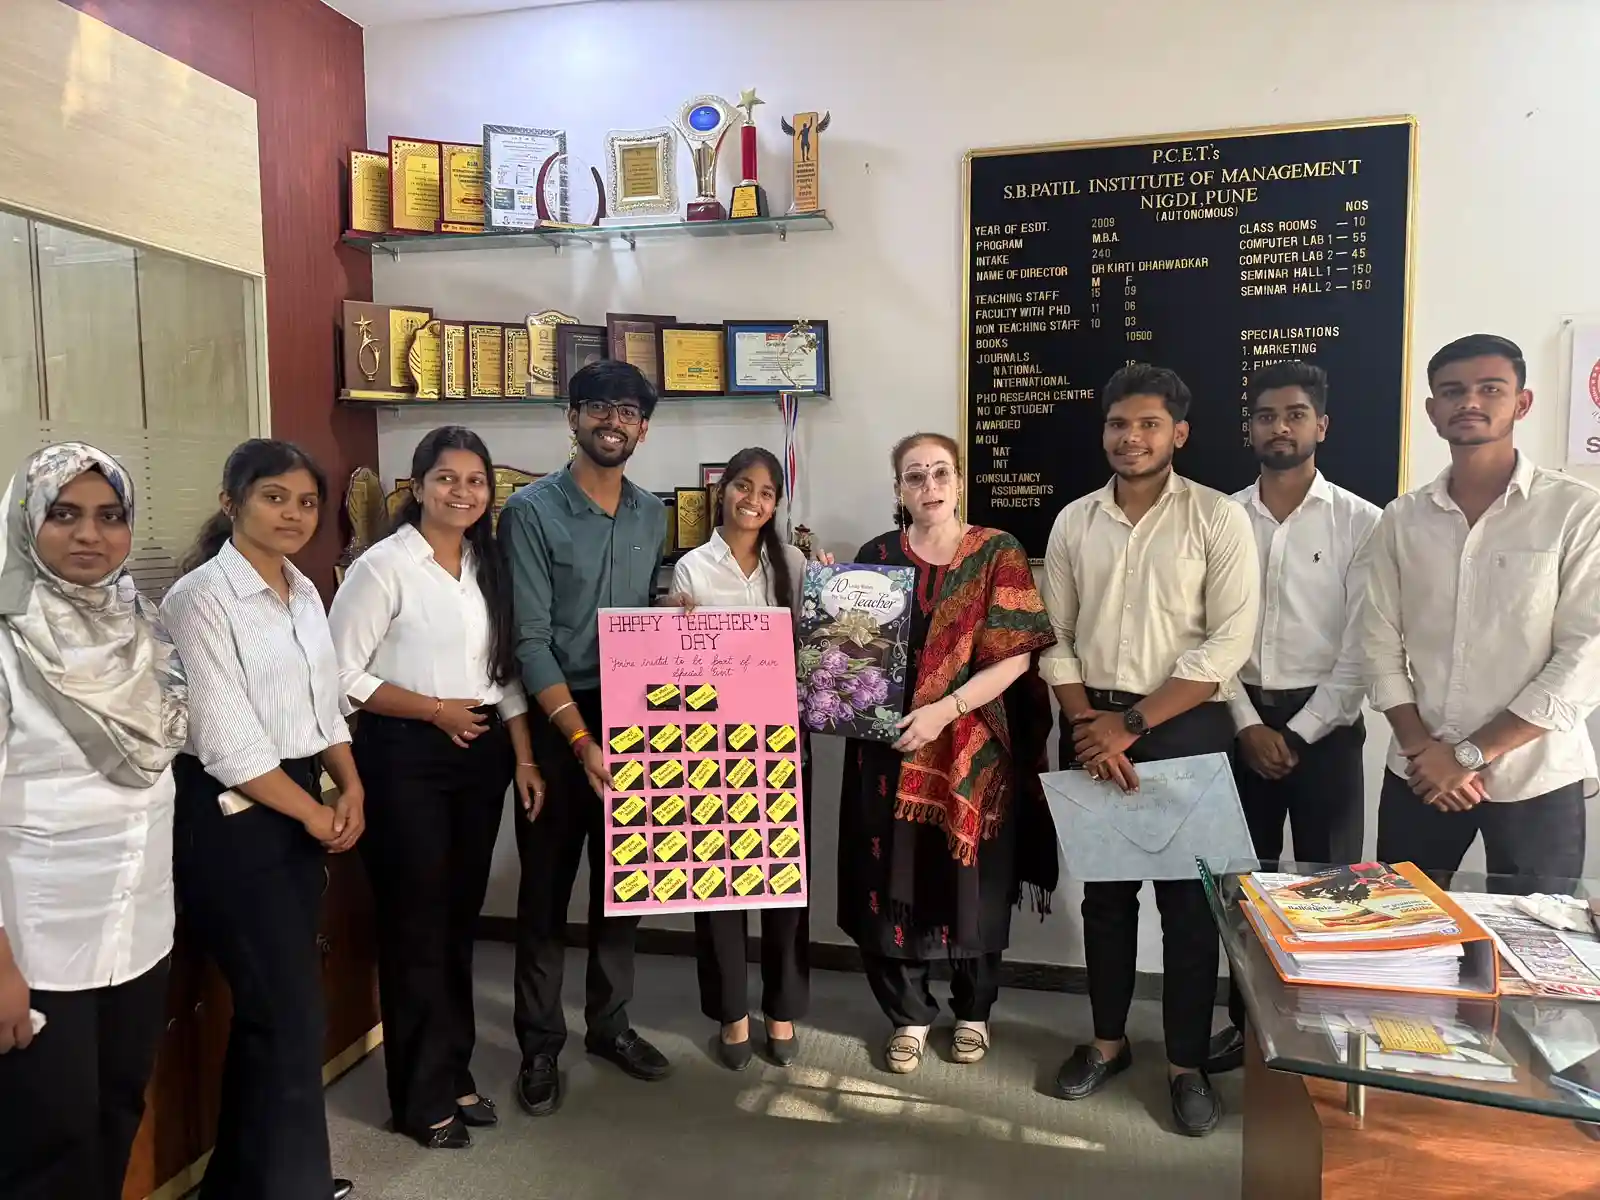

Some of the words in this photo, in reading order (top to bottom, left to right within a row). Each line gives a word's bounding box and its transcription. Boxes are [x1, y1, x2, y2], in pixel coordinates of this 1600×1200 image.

[1004, 180, 1080, 199] S.B.PATIL
[1089, 172, 1184, 193] INSTITUTE
[1190, 171, 1214, 185] OF
[1221, 160, 1361, 183] MANAGEMENT
[1346, 200, 1368, 212] NOS
[1156, 207, 1238, 221] (AUTONOMOUS)
[975, 225, 1000, 236] YEAR
[1005, 224, 1017, 234] OF
[1021, 222, 1050, 233] ESDT.
[1092, 218, 1114, 228] 2009
[1240, 223, 1274, 234] CLASS
[1279, 220, 1317, 231] ROOMS
[1354, 216, 1366, 227] 10
[1092, 232, 1119, 243] M.B.A.
[1240, 236, 1298, 250] COMPUTER
[1303, 235, 1324, 246] LAB
[1328, 234, 1332, 244] 1
[1353, 232, 1366, 242] 55
[976, 239, 1023, 251] PROGRAM
[1092, 248, 1111, 258] 240
[1240, 252, 1298, 265] COMPUTER
[1302, 251, 1323, 262] LAB
[1328, 250, 1333, 260] 2
[1352, 248, 1366, 258] 45
[976, 255, 1009, 266] INTAKE
[1092, 264, 1104, 274] DR
[1108, 262, 1134, 273] KIRTI
[1139, 257, 1208, 271] DHARWADKAR
[976, 270, 1003, 281] NAME
[1006, 270, 1018, 279] OF
[1020, 266, 1068, 279] DIRECTOR
[1240, 269, 1288, 280] SEMINAR
[1294, 267, 1323, 278] HALL
[1327, 266, 1331, 276] 1
[1352, 264, 1371, 274] 150
[1092, 277, 1100, 287] M
[1126, 276, 1132, 285] F
[1241, 284, 1287, 296] SEMINAR
[1293, 282, 1322, 293] HALL
[1325, 282, 1332, 292] 2
[1352, 280, 1371, 290] 150
[975, 292, 1022, 304] TEACHING
[1026, 291, 1060, 302] STAFF
[1091, 288, 1100, 298] 15
[1125, 286, 1136, 295] 09
[976, 308, 1017, 319] FACULTY
[1020, 306, 1044, 317] WITH
[1049, 305, 1070, 316] PHD
[1092, 304, 1099, 313] 11
[1125, 301, 1136, 311] 06
[976, 324, 995, 335] NON
[998, 322, 1046, 333] TEACHING
[1050, 320, 1080, 330] STAFF
[1091, 318, 1100, 328] 10
[1125, 317, 1136, 326] 03
[1240, 327, 1340, 340] SPECIALISATIONS
[976, 339, 1008, 349] BOOKS
[1126, 331, 1152, 341] 10500
[1242, 346, 1250, 355] 1.
[1253, 343, 1317, 355] MARKETING
[976, 352, 1030, 364] JOURNALS
[993, 365, 1042, 376] NATIONAL
[1242, 361, 1251, 370] 2.
[993, 376, 1070, 388] INTERNATIONAL
[977, 393, 997, 404] PHD
[1000, 391, 1050, 402] RESEARCH
[1054, 389, 1094, 400] CENTRE
[977, 406, 990, 416] NO
[994, 405, 1007, 415] OF
[1010, 404, 1056, 415] STUDENT
[1242, 407, 1250, 416] 5.
[976, 420, 1021, 430] AWARDED
[976, 435, 998, 444] MOU
[993, 447, 1011, 456] NAT
[993, 460, 1008, 469] INT
[976, 473, 1040, 483] CONSULTANCY
[992, 485, 1054, 495] ASSIGNMENTS
[991, 498, 1040, 508] PROJECTS
[831, 578, 848, 592] 10
[848, 590, 896, 609] Teacher
[609, 616, 663, 632] HAPPY
[672, 614, 770, 631] TEACHER'S
[681, 634, 720, 650] DAY
[672, 655, 685, 665] to
